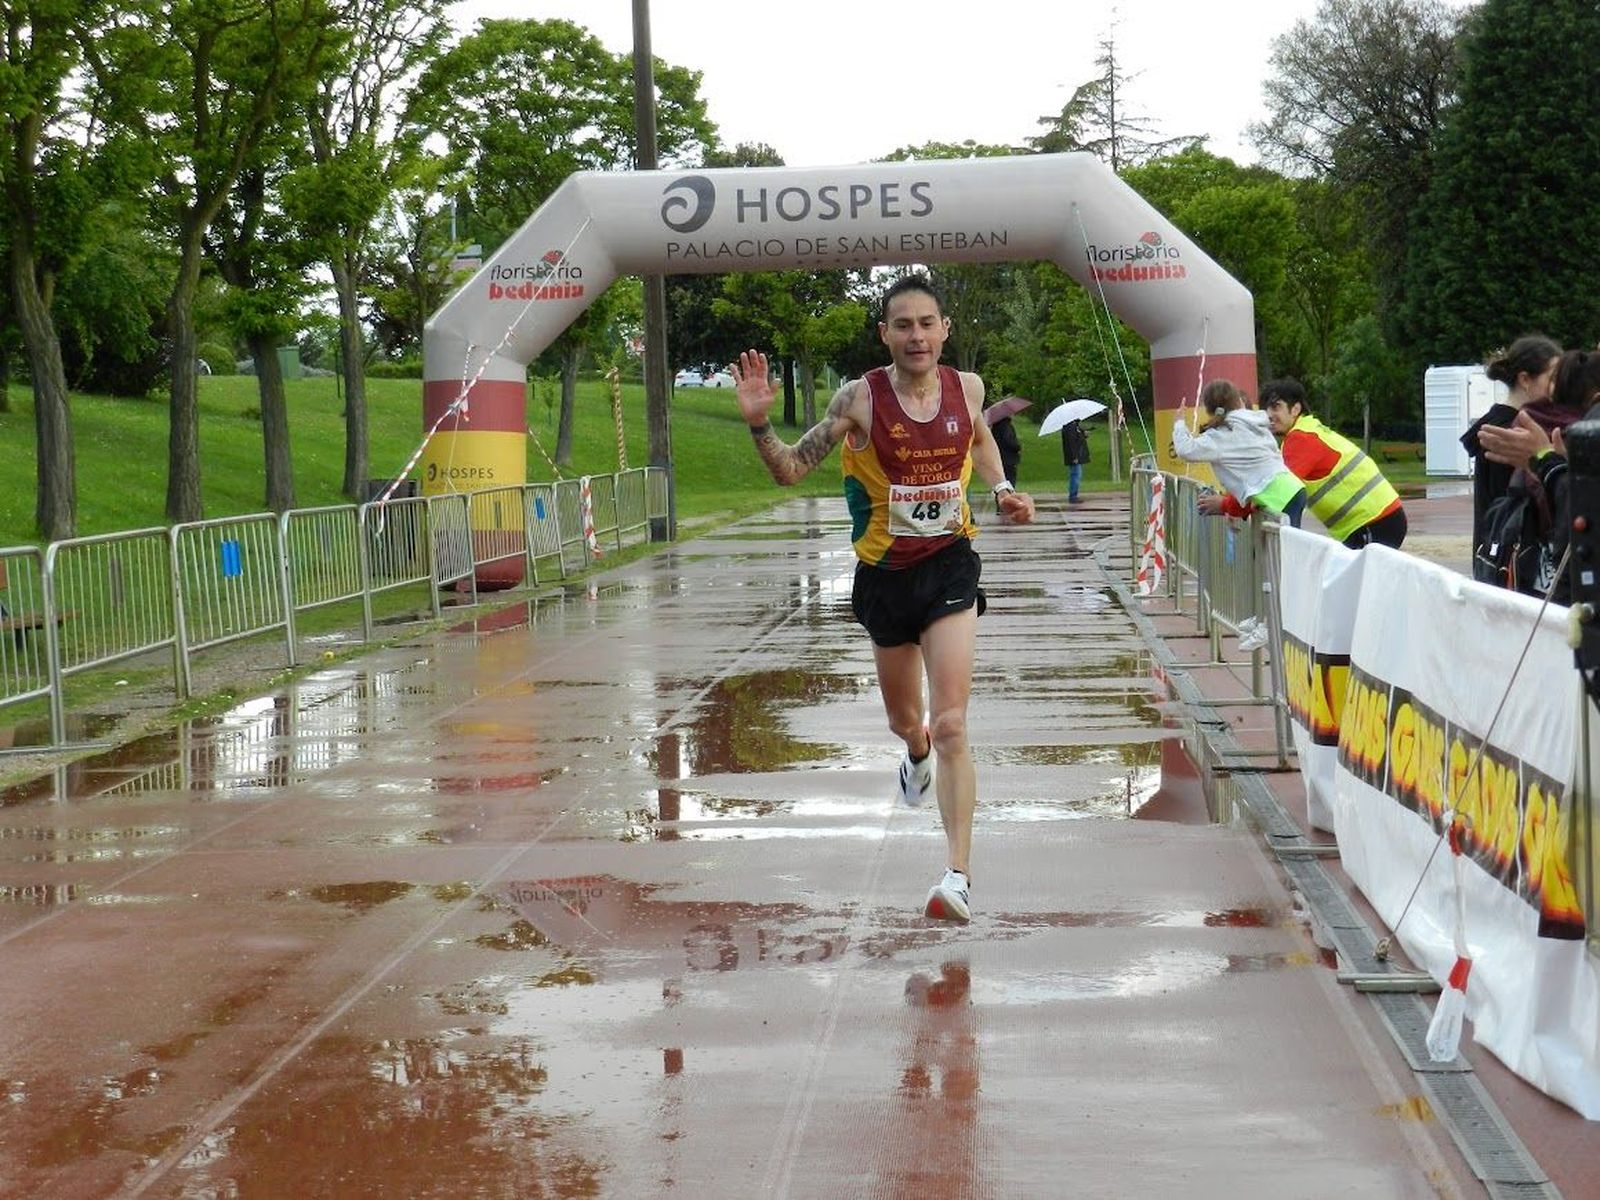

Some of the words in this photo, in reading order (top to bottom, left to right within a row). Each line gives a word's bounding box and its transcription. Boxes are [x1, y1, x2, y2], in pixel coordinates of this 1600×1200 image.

[736, 181, 934, 223] HOSPES
[667, 239, 785, 259] PALACIO
[796, 237, 828, 255] DE
[838, 235, 889, 254] SAN
[901, 230, 1008, 251] ESTEBAN
[441, 467, 495, 479] HOSPES
[912, 462, 943, 473] VINO
[902, 475, 918, 485] DE
[920, 471, 952, 484] TORO
[912, 501, 941, 521] 48
